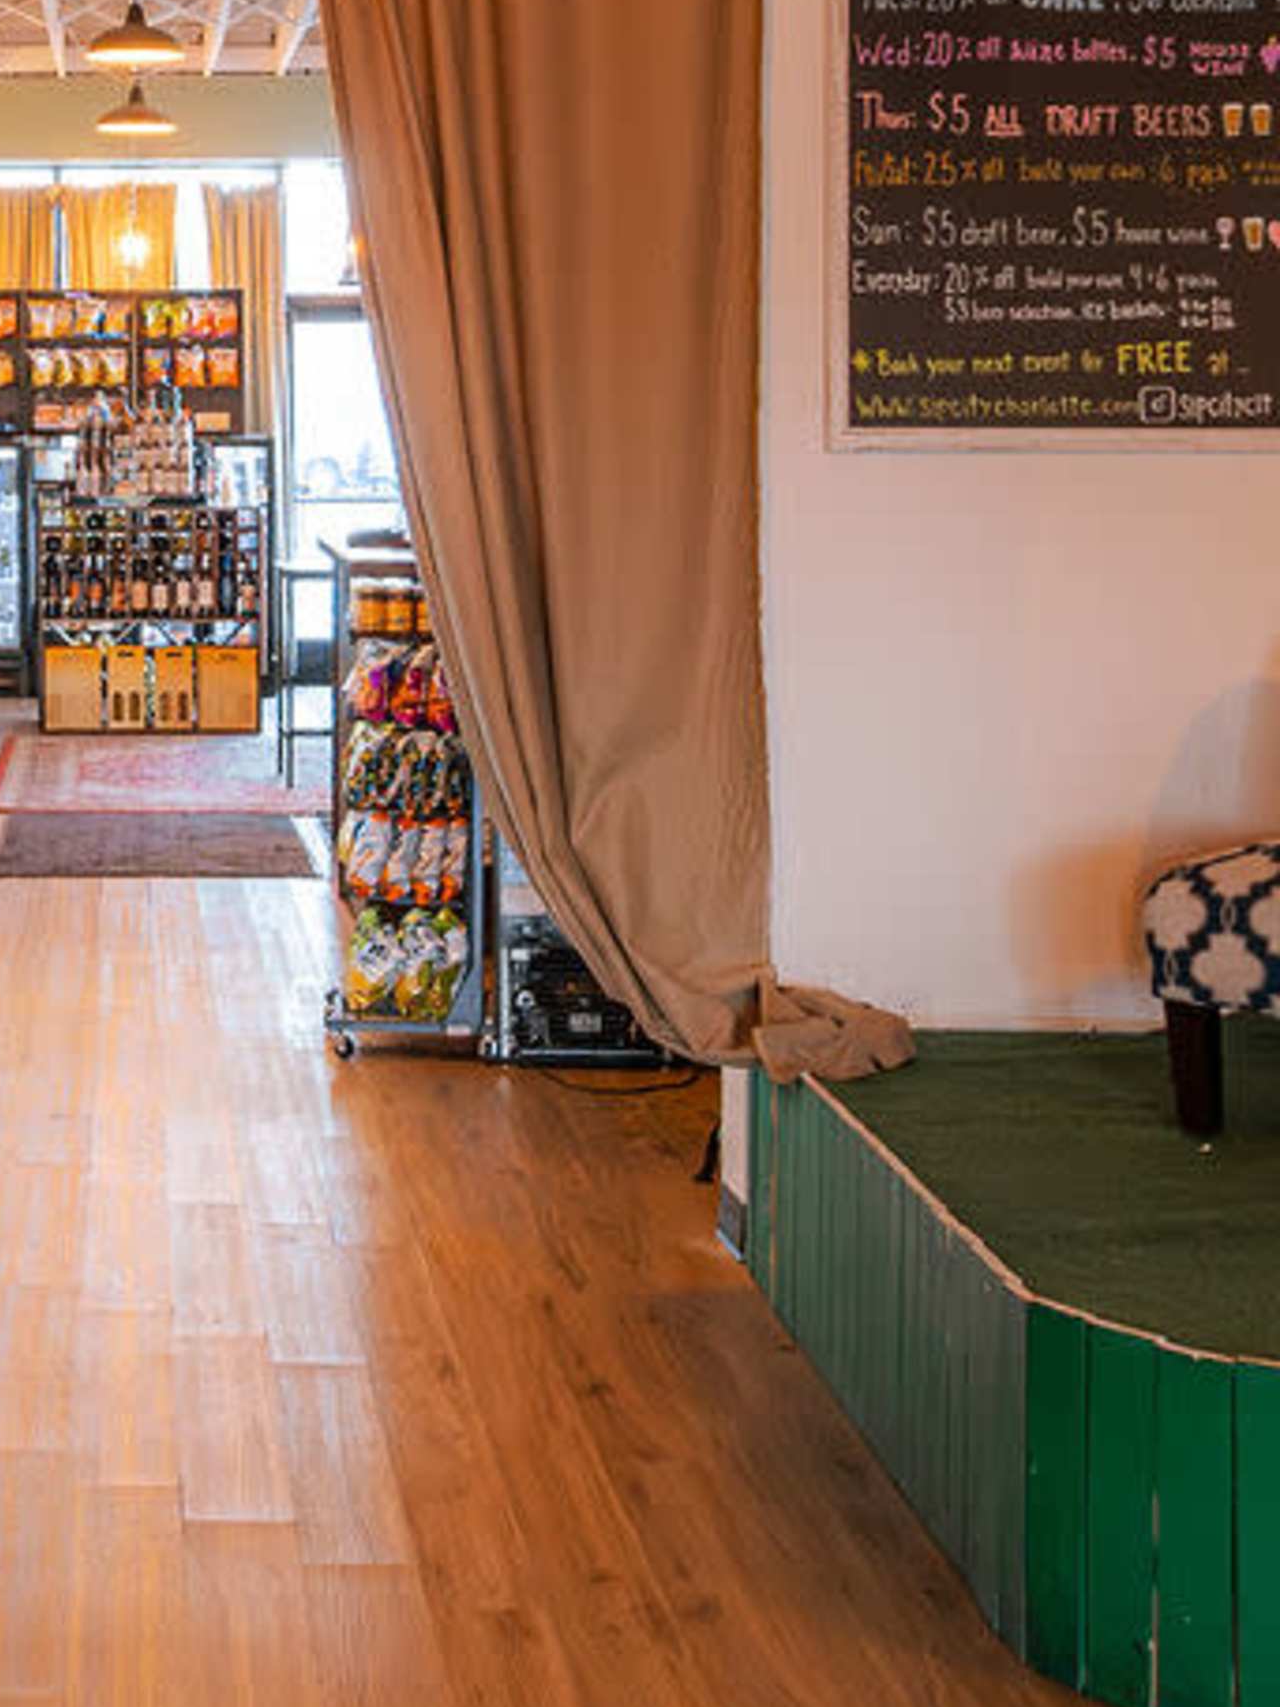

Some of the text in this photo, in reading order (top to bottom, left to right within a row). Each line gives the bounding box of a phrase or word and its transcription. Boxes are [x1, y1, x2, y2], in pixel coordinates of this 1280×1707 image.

[853, 32, 920, 67] Wed:
[922, 30, 972, 68] 20%
[1142, 34, 1177, 69] $5
[928, 91, 971, 135] $5
[1045, 103, 1120, 137] DRAFT
[1132, 103, 1212, 137] BEERS
[852, 205, 912, 246] Sun:
[922, 205, 957, 246] $5
[1072, 205, 1108, 247] $5
[1115, 340, 1192, 376] FREE
